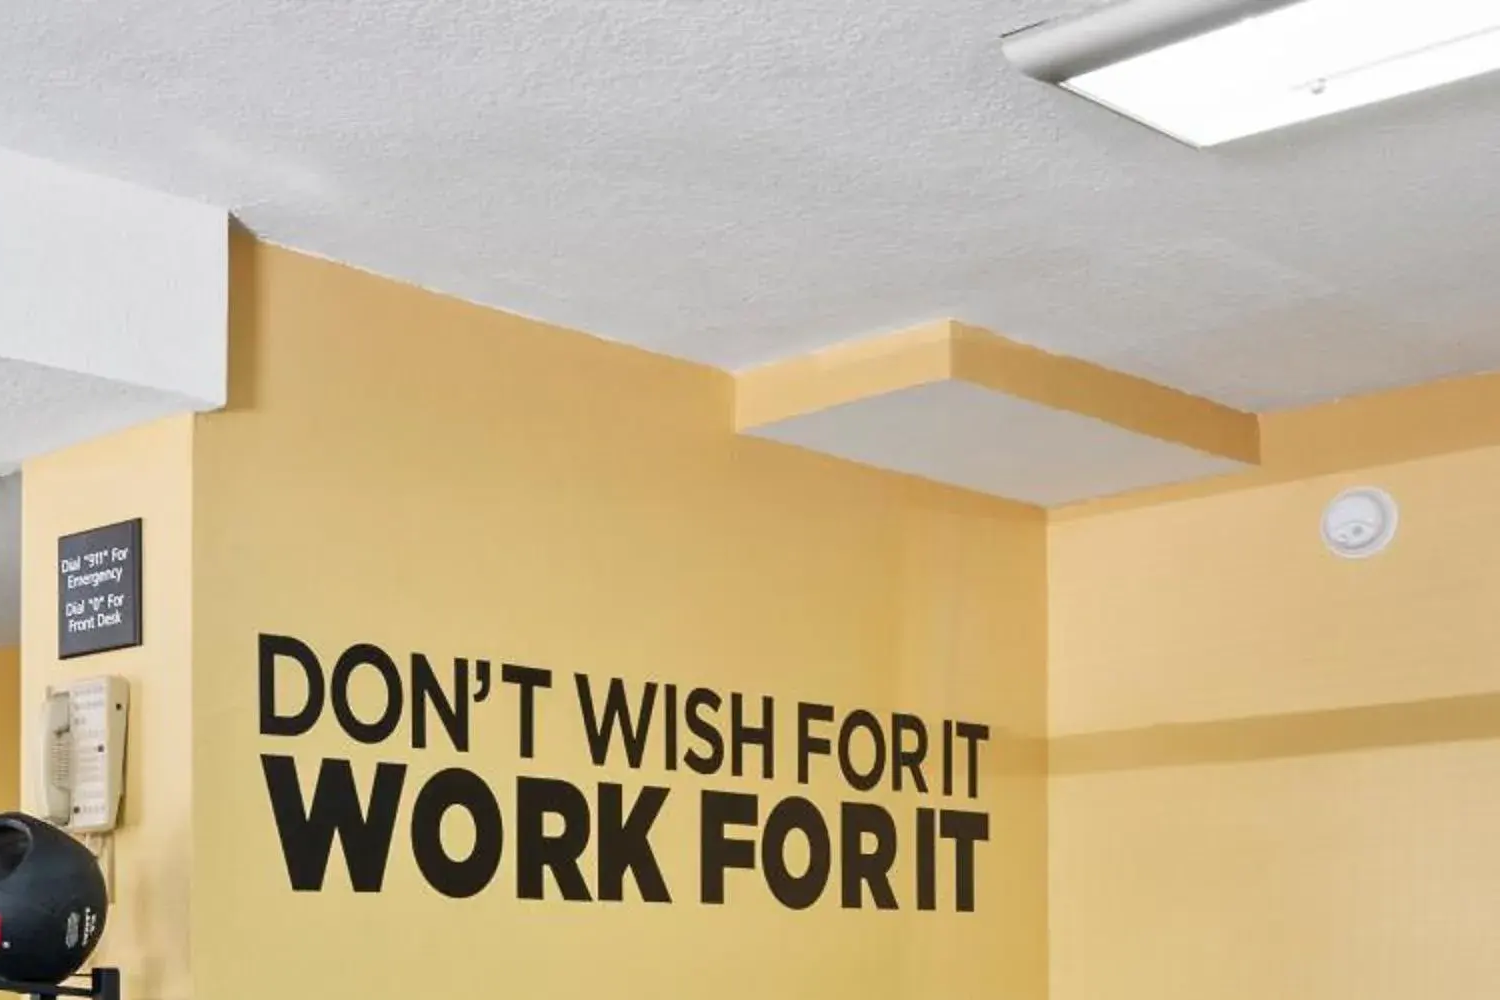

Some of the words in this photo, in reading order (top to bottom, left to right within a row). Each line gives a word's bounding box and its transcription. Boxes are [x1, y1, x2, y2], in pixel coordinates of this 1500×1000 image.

[61, 555, 82, 573] Dial
[111, 547, 129, 562] For
[67, 566, 123, 589] Emergency
[65, 599, 85, 617] Dial
[107, 593, 125, 608] For
[68, 617, 95, 632] Front
[97, 609, 122, 627] Desk
[259, 634, 551, 758] DON'T
[575, 674, 774, 778] WISH
[798, 703, 929, 792] FOR
[944, 720, 990, 798] IT
[260, 754, 672, 902] WORK
[702, 789, 899, 909] FOR
[917, 807, 989, 912] IT
